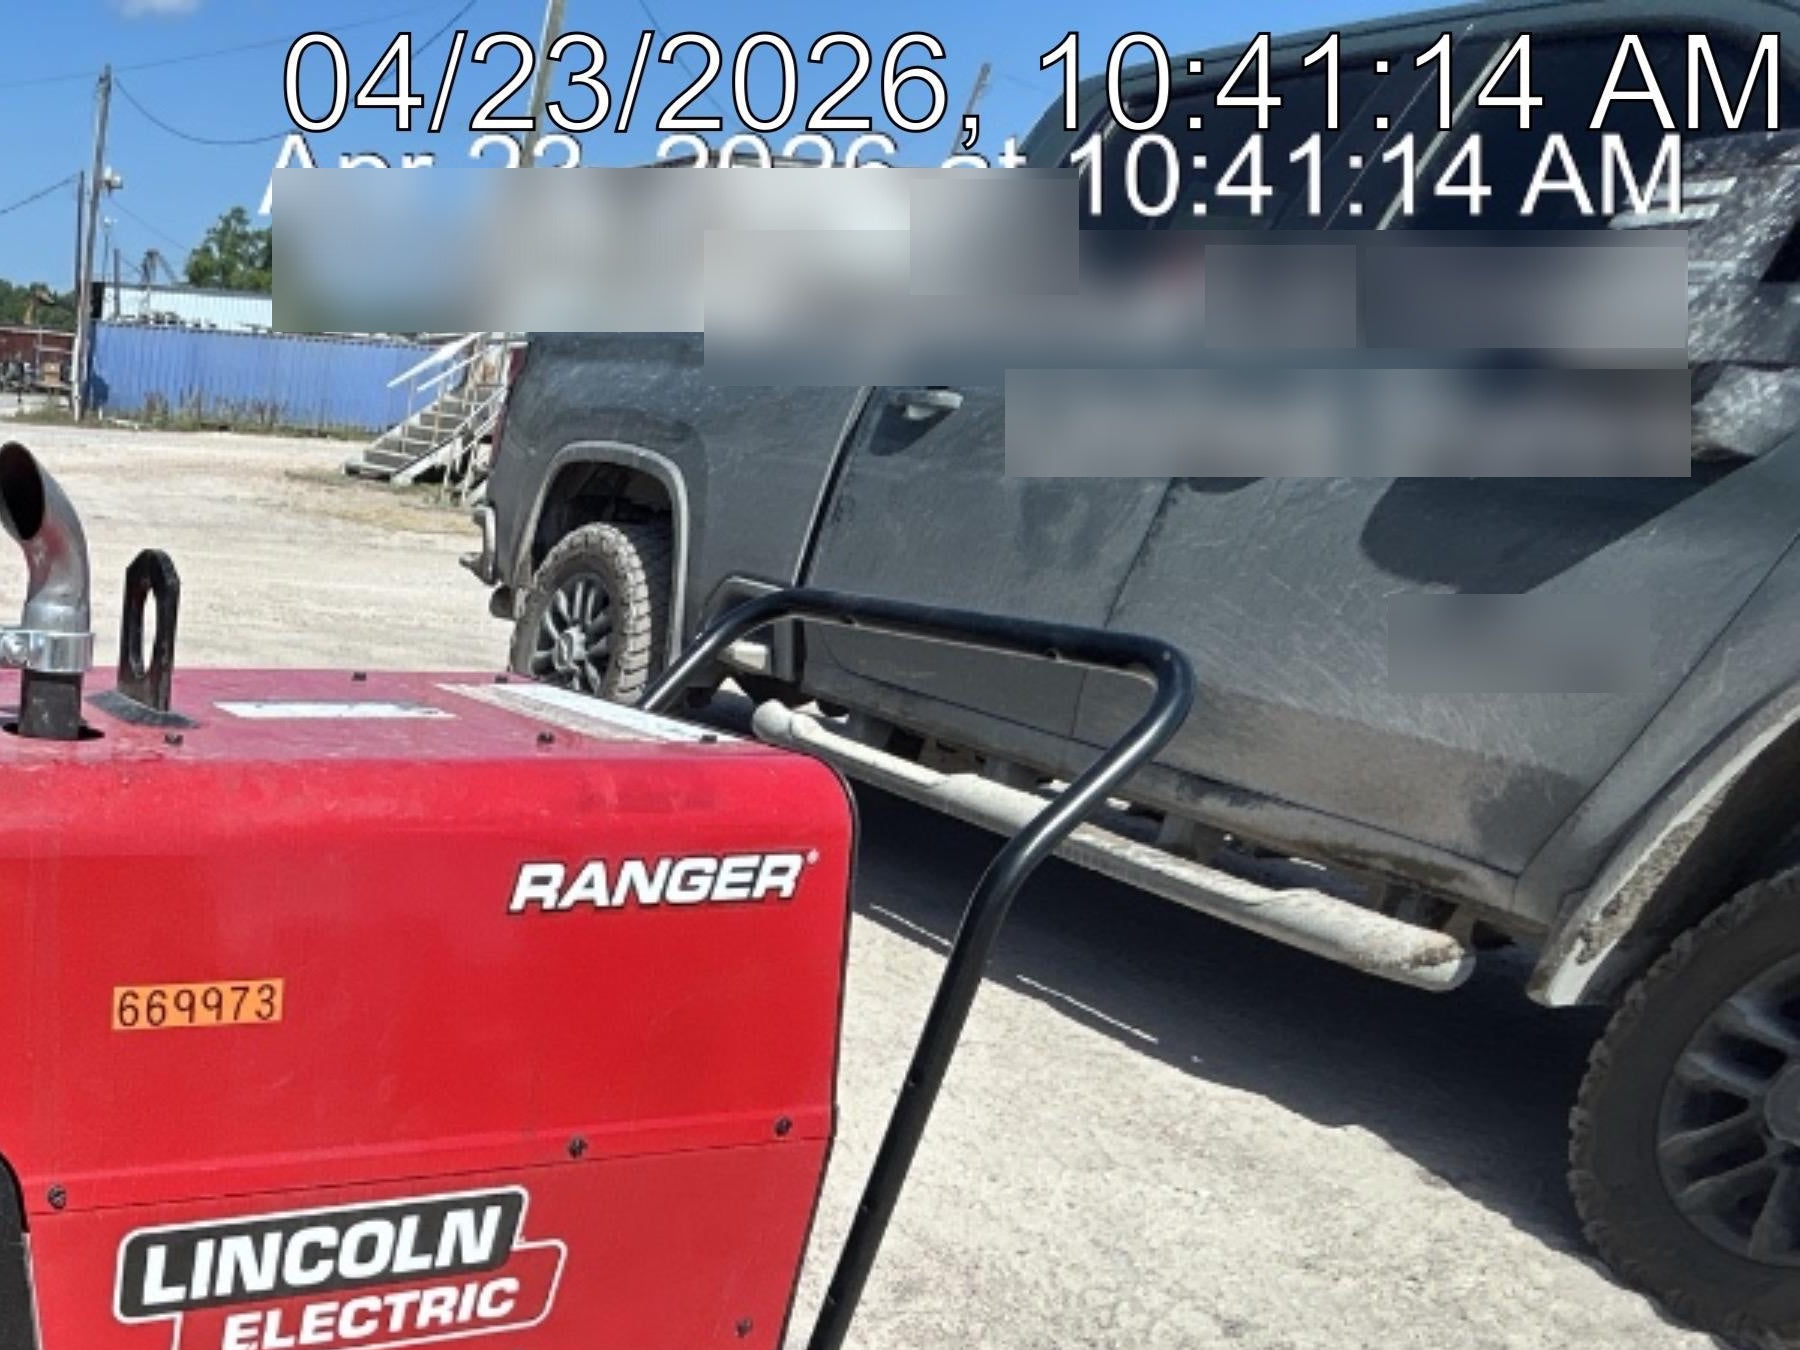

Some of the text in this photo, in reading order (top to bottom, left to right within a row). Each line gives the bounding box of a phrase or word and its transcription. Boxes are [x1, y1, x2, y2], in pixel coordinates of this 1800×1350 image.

[508, 852, 806, 913] RANGER
[117, 983, 277, 1027] 669973
[142, 1206, 503, 1306] LINCOLN
